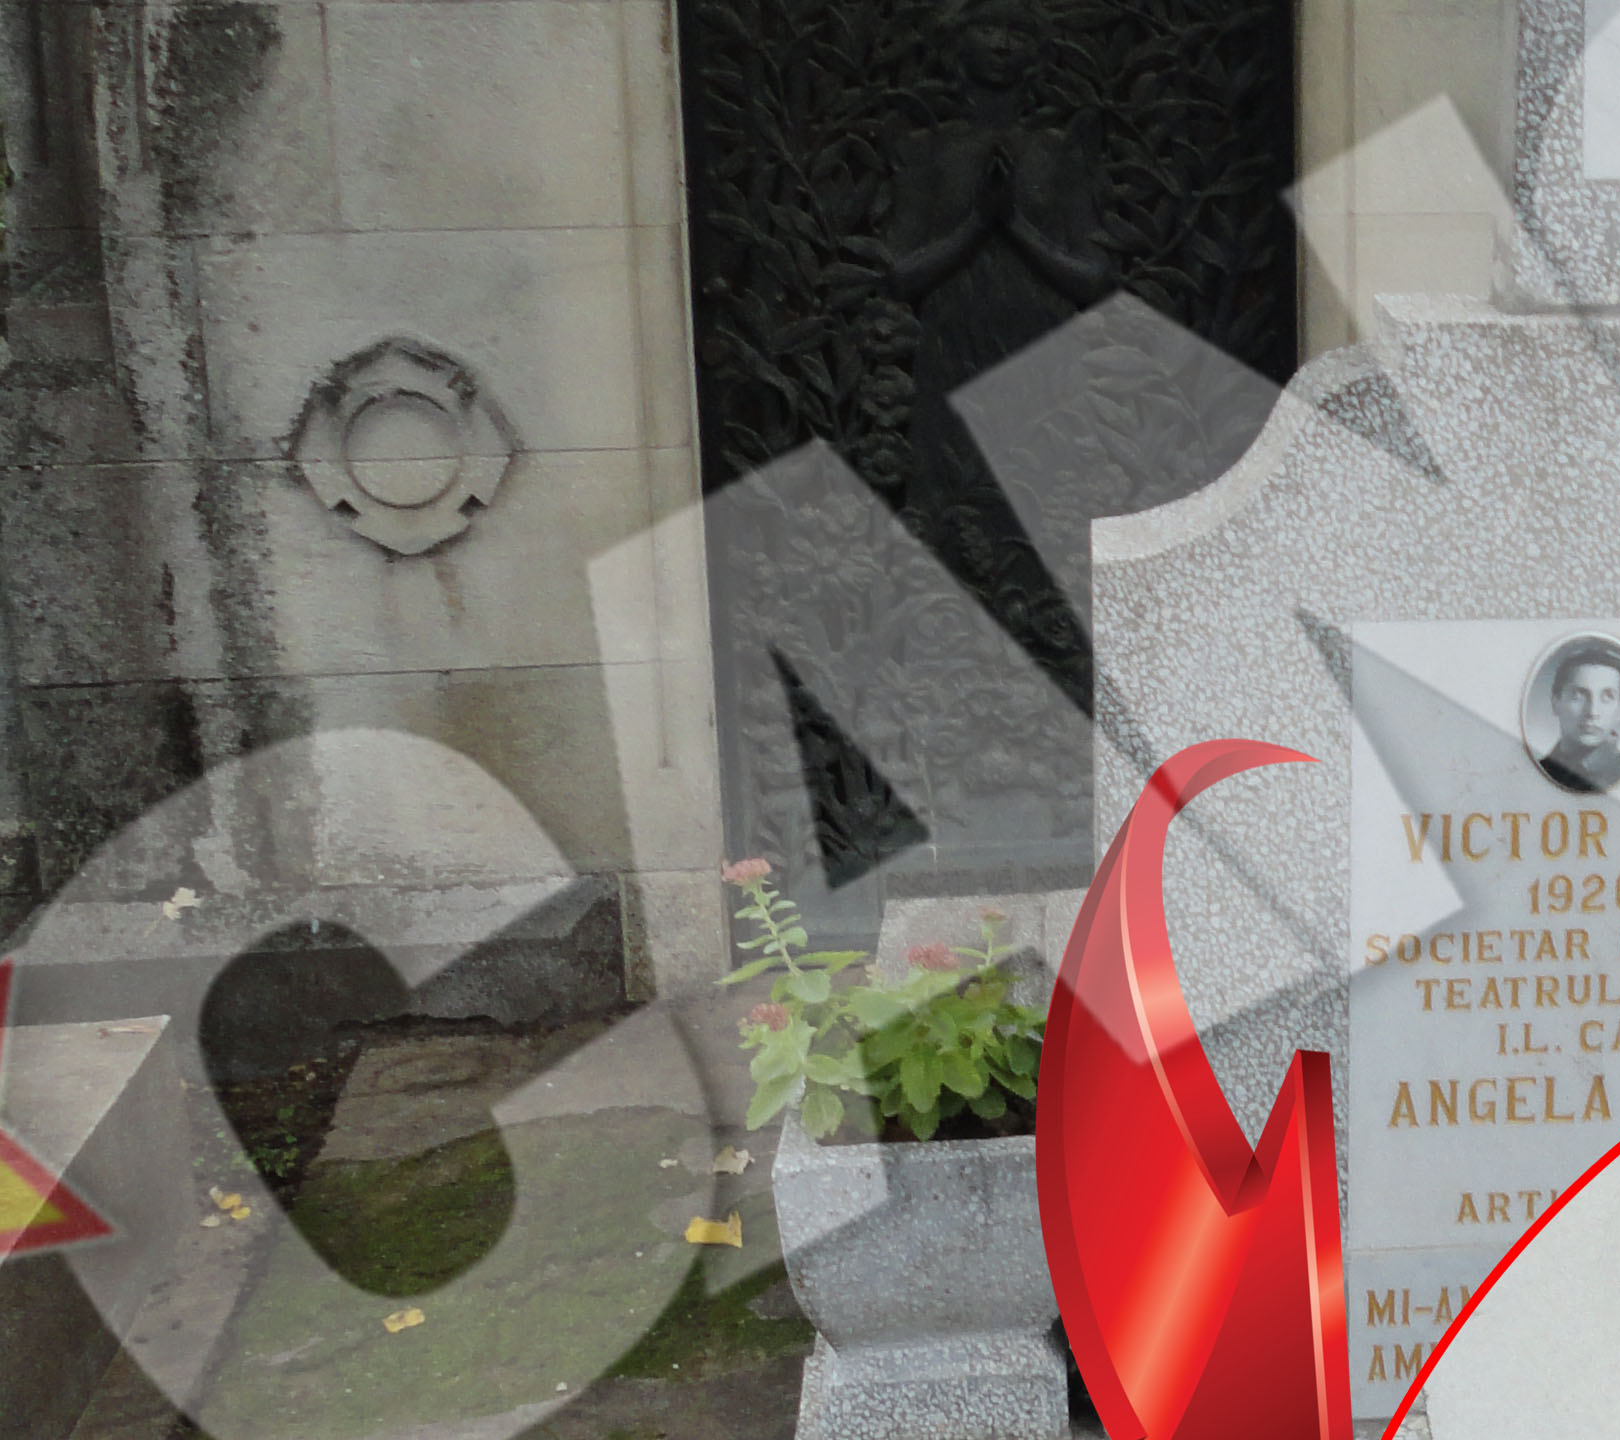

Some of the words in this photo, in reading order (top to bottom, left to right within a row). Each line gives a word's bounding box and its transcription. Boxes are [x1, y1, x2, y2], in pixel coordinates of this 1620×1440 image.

[1402, 810, 1609, 863] VICTOR
[1366, 929, 1590, 966] SOCIETAR
[1497, 1022, 1563, 1056] I.L.
[1387, 1075, 1612, 1127] ANGELA
